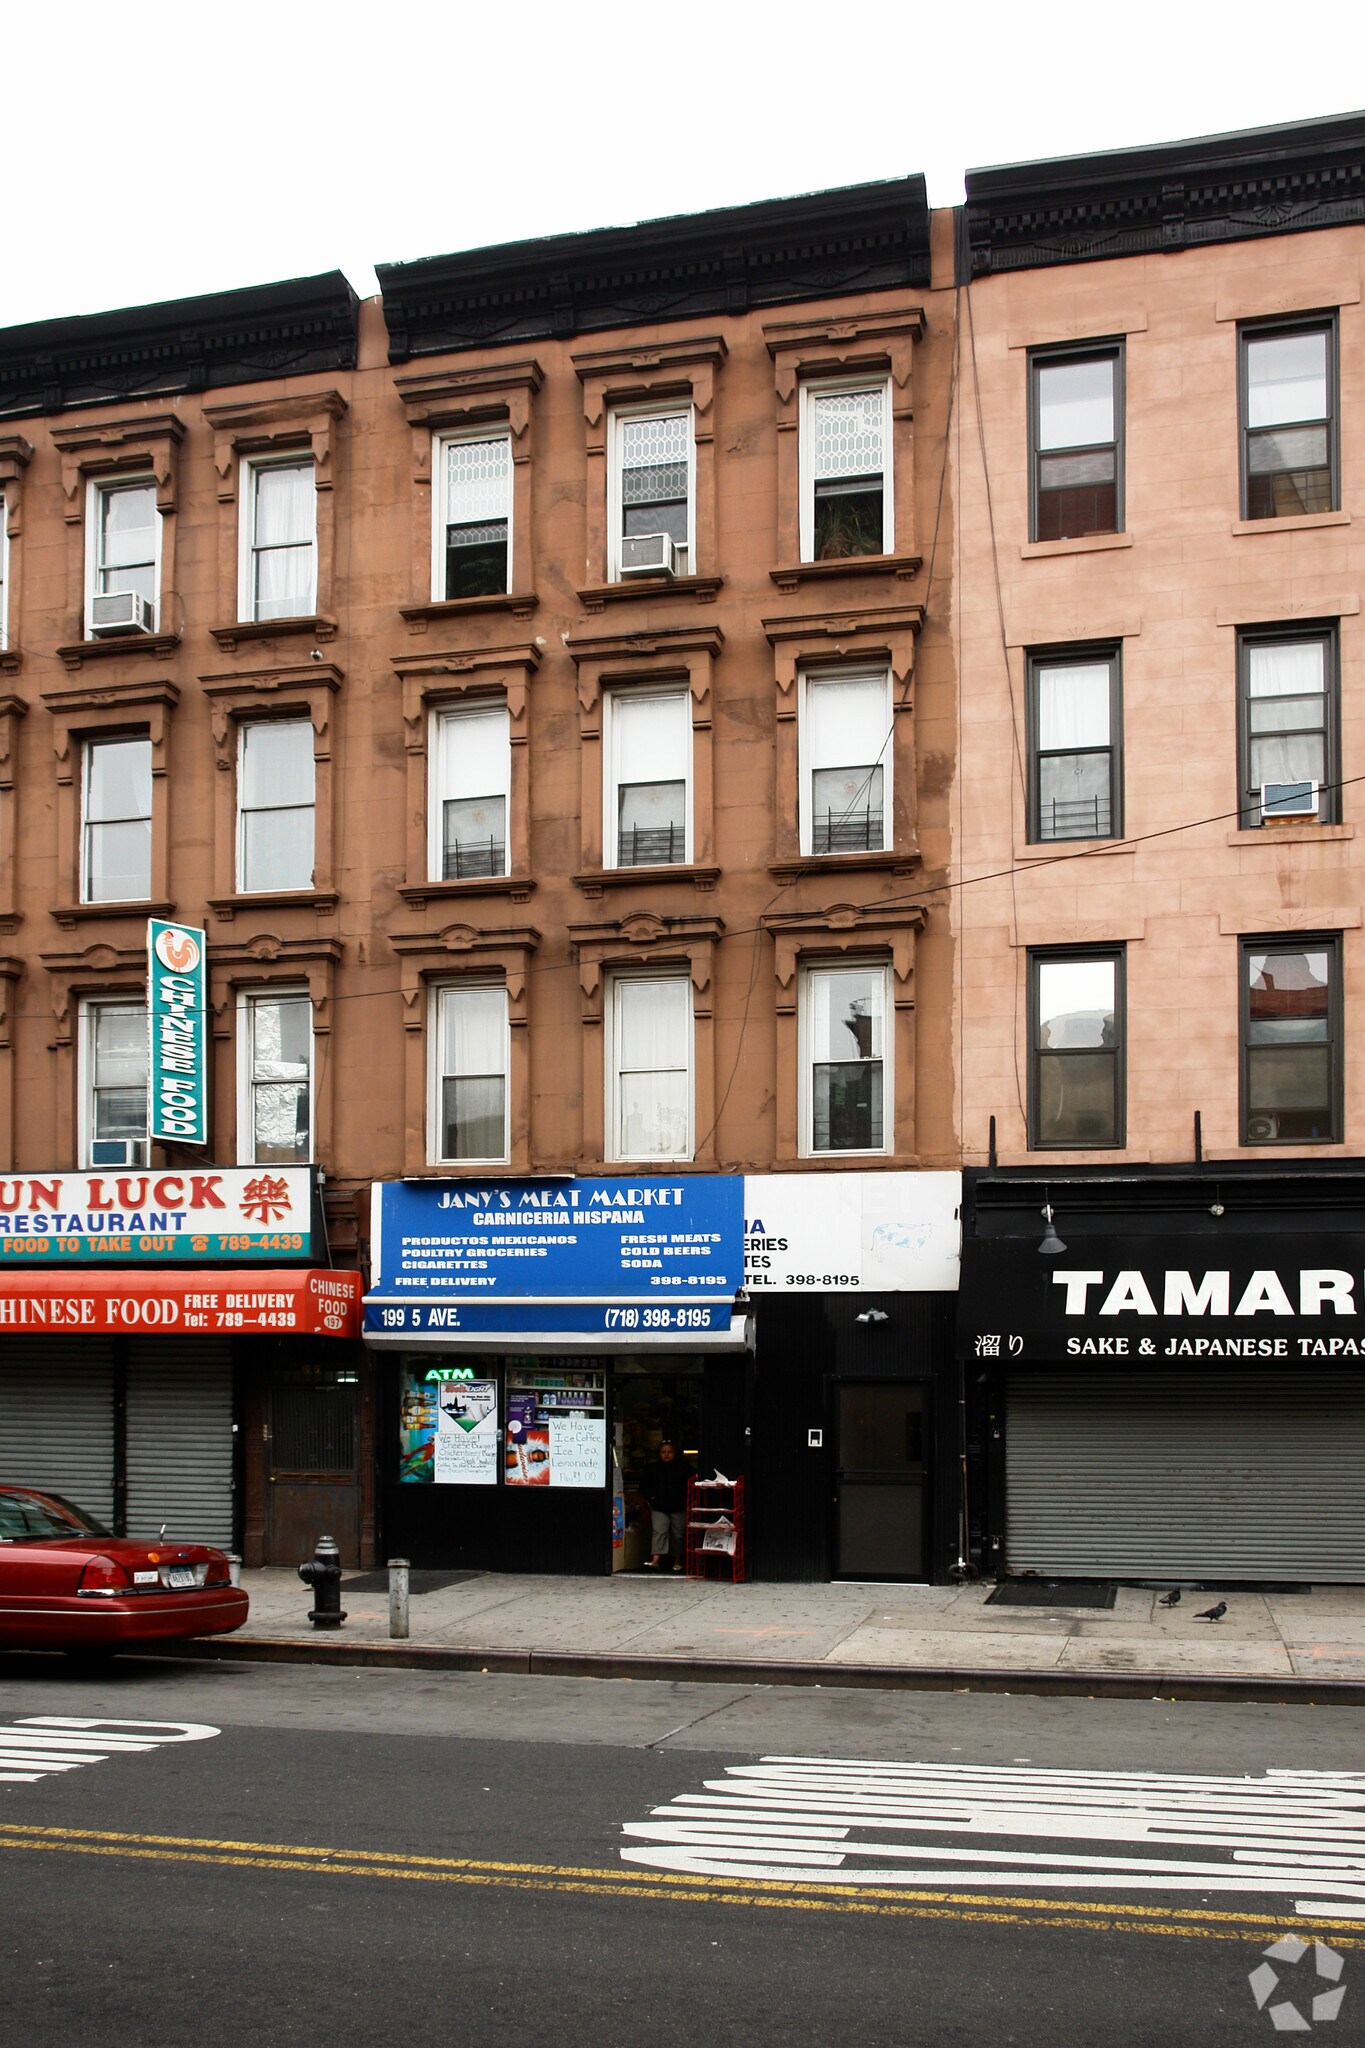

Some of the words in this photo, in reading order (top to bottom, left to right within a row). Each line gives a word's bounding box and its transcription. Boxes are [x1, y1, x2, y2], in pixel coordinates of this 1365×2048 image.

[159, 976, 197, 1075] CHINESE
[160, 1076, 198, 1135] FOOD
[86, 1175, 227, 1212] LUCK
[238, 1173, 293, 1226] 樂
[437, 1189, 511, 1209] JANY'S
[518, 1189, 581, 1208] MEAT
[588, 1187, 685, 1207] MARKET
[0, 1212, 187, 1234] RESTAURANT
[472, 1211, 571, 1226] CARNICERIA
[573, 1210, 645, 1225] HISPANA
[3, 1237, 49, 1253] FOOD
[56, 1236, 80, 1252] TO
[88, 1236, 132, 1252] TAKE
[139, 1235, 176, 1251] OUT
[218, 1234, 303, 1250] 789-4439
[401, 1235, 489, 1246] PRODUCTOS
[491, 1235, 578, 1245] MEXICANOS
[621, 1234, 668, 1243] FRESH
[670, 1233, 722, 1243] MEATS
[401, 1248, 464, 1258] POULTRY
[466, 1247, 548, 1257] GROCERIES
[621, 1246, 661, 1256] COLD
[663, 1246, 712, 1256] BEERS
[401, 1260, 488, 1270] CIGARETTES
[621, 1259, 663, 1269] SODA
[395, 1277, 428, 1286] FREE
[429, 1276, 497, 1286] DELIVERY
[650, 1275, 727, 1285] 398-8195
[744, 1274, 777, 1285] TEL.
[785, 1274, 860, 1286] 398-8195
[310, 1278, 355, 1299] CHINESE
[1052, 1269, 1365, 1316] TAMAR
[184, 1294, 218, 1309] FREE
[226, 1293, 295, 1309] DELIVERY
[318, 1298, 348, 1316] FOOD
[105, 1298, 179, 1325] FOOD
[381, 1308, 405, 1327] 199
[411, 1308, 421, 1327] 5
[428, 1308, 461, 1327] AVE.
[604, 1307, 639, 1328] (718)
[642, 1308, 711, 1327] 398-8195
[183, 1312, 208, 1328] Tel:
[215, 1312, 296, 1328] 789-4439
[326, 1317, 340, 1328] 197
[1066, 1337, 1129, 1356] SAKE
[1140, 1338, 1157, 1356] &
[1164, 1337, 1288, 1357] JAPANESE
[425, 1368, 474, 1381] ATM
[552, 1421, 567, 1431] We
[570, 1421, 594, 1431] Have
[554, 1433, 575, 1443] Ice
[553, 1445, 573, 1455] Ice
[551, 1457, 598, 1468] Lemonade
